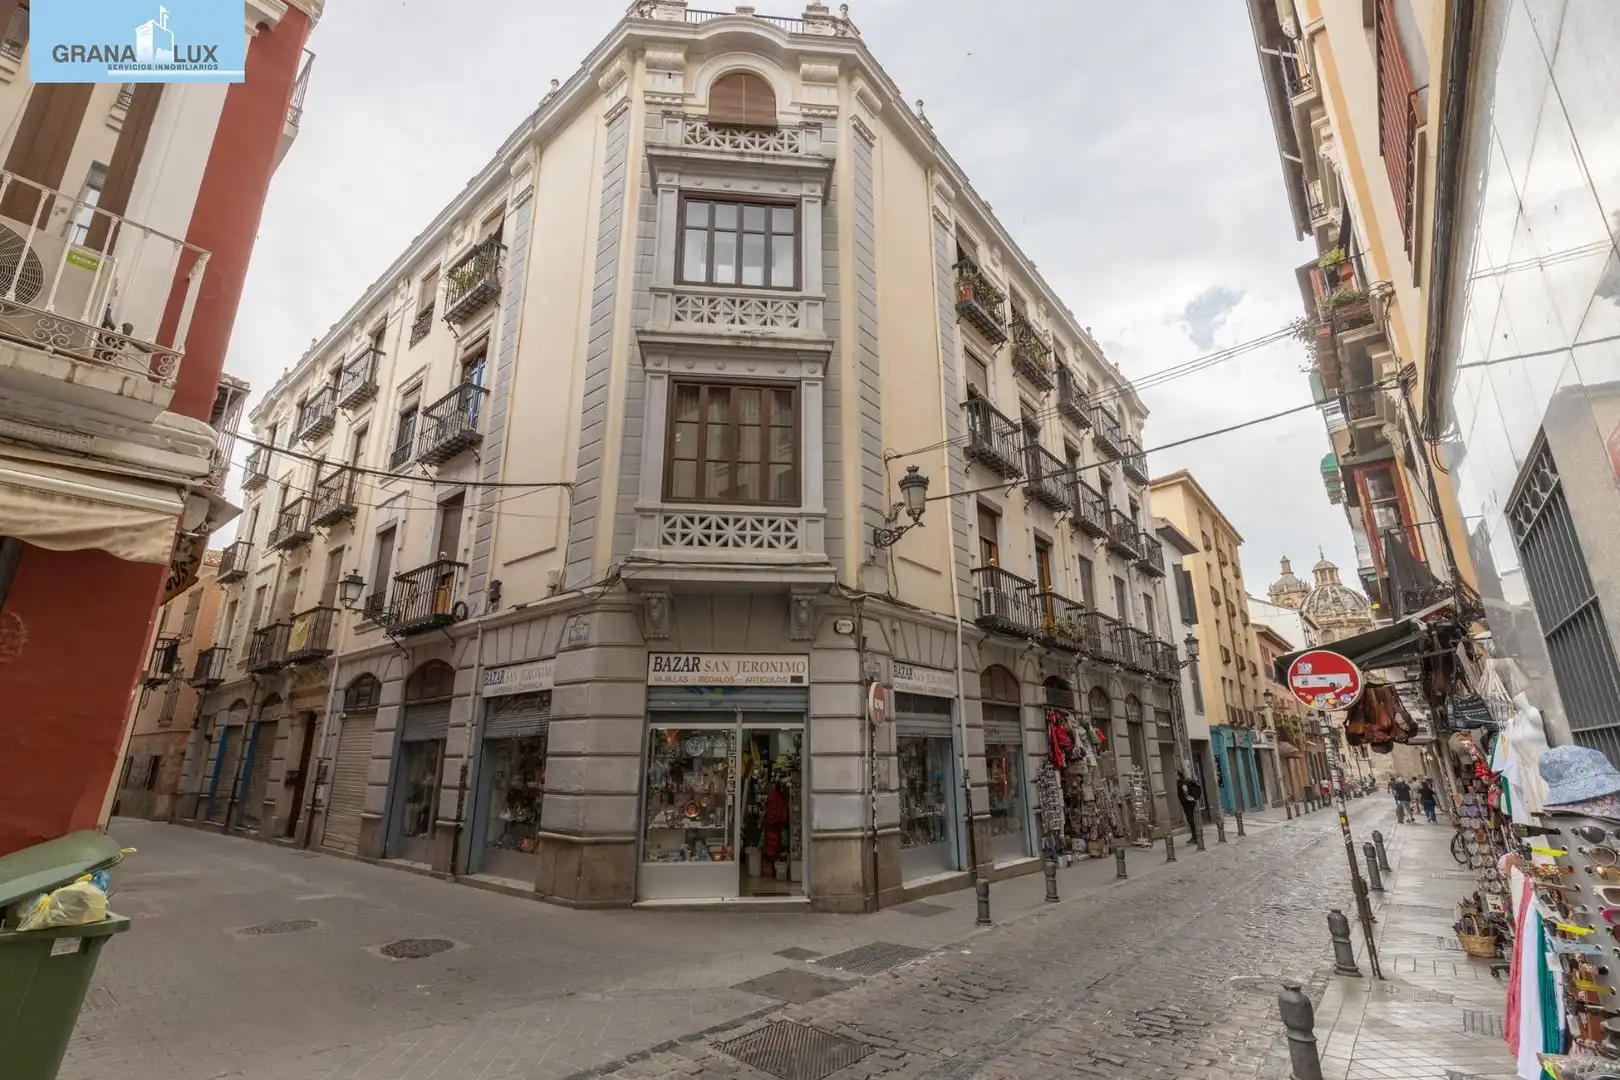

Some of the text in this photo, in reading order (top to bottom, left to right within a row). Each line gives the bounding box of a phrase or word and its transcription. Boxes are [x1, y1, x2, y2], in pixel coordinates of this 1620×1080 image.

[652, 656, 806, 677] BAZAR SAN JERONIMO
[893, 663, 913, 681] BAZAR
[484, 669, 505, 687] BAZAR
[654, 675, 689, 684] VAJILLAS
[698, 675, 735, 684] REGALOS
[744, 676, 788, 684] ARTICULOS
